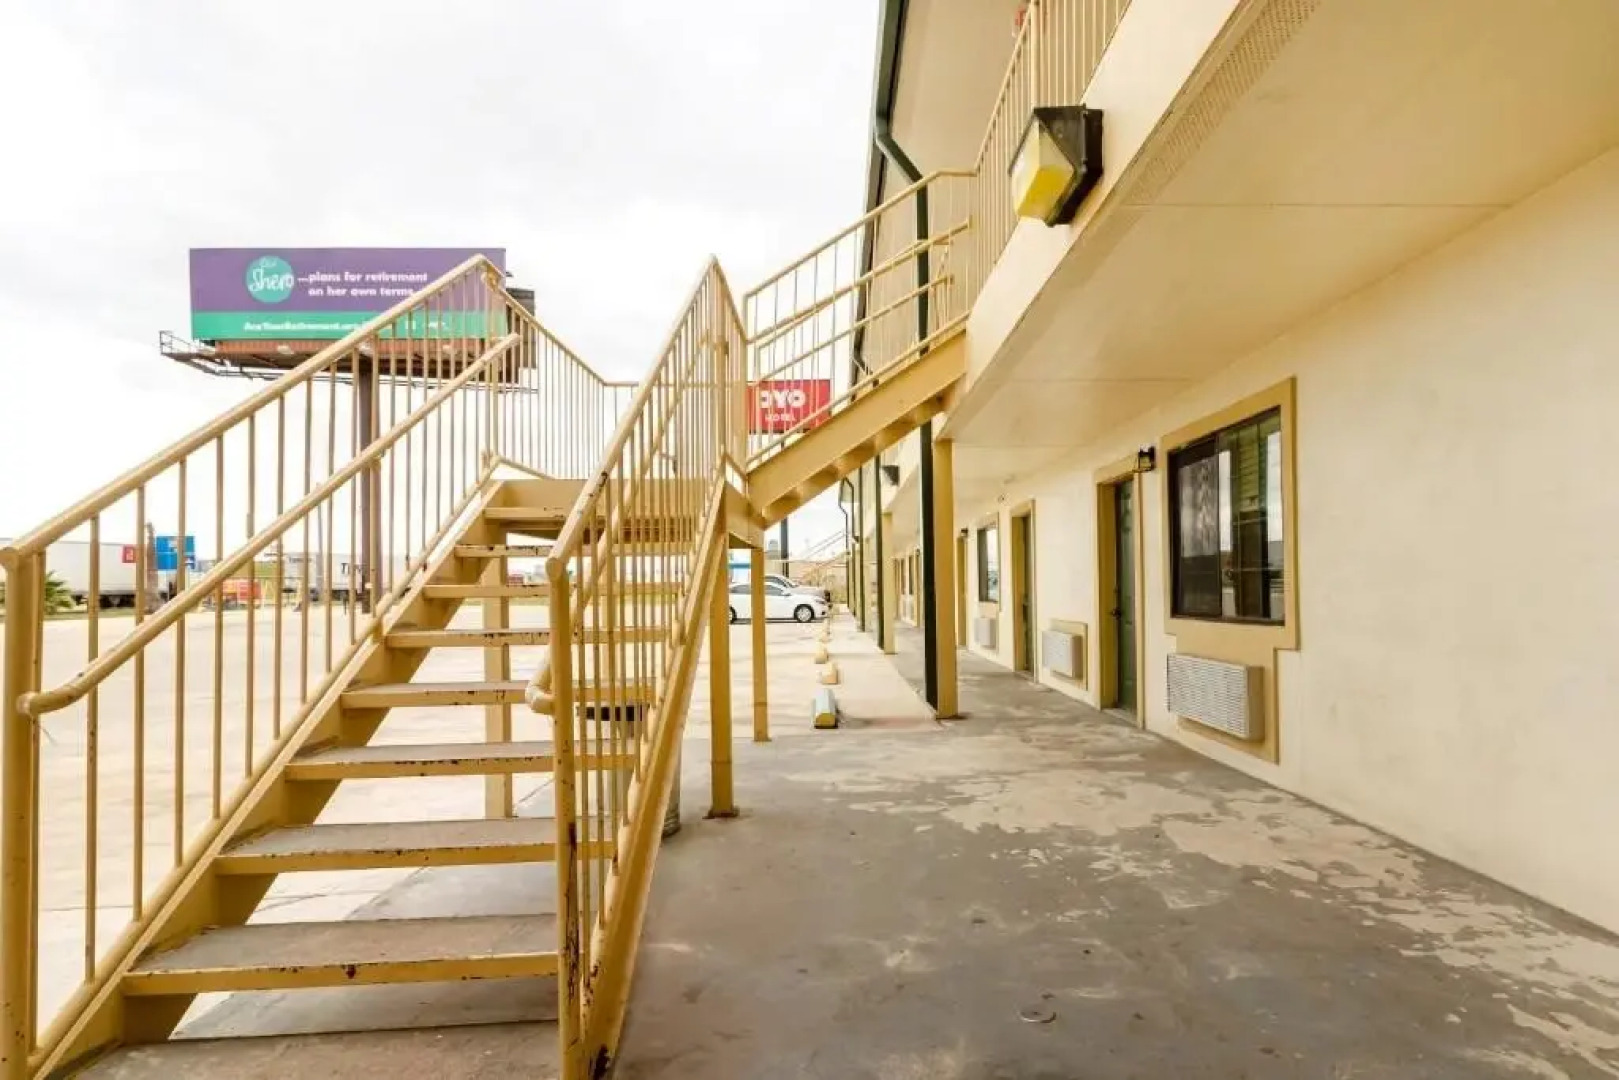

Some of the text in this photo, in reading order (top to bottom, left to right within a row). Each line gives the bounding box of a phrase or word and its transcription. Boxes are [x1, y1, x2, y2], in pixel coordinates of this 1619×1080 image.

[344, 271, 362, 282] for
[365, 271, 427, 282] retirement
[308, 288, 323, 296] on
[327, 286, 347, 296] her
[350, 288, 377, 296] own
